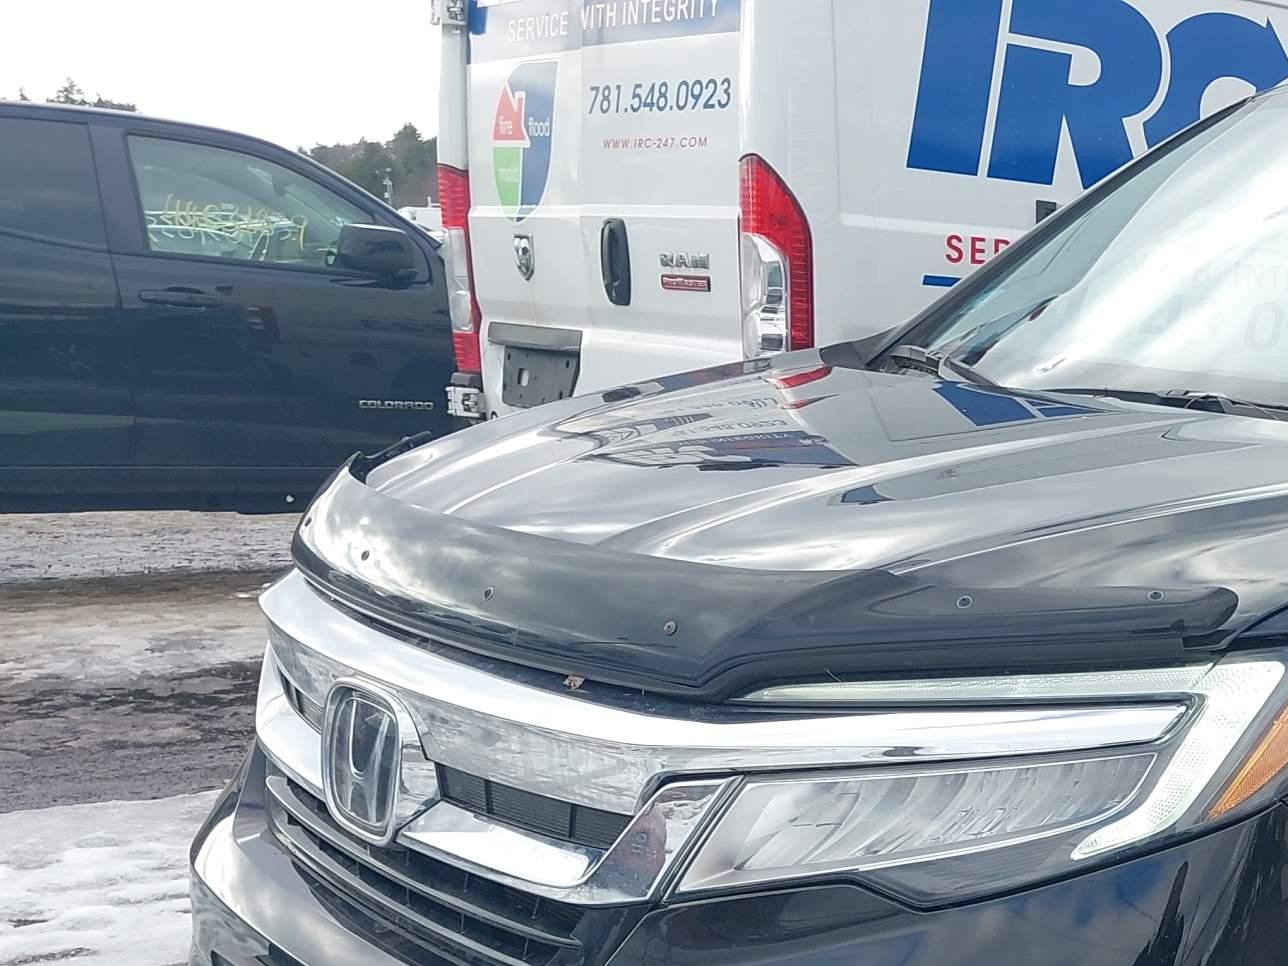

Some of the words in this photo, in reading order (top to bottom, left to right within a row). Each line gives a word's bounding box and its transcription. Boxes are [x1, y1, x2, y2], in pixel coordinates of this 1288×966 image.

[507, 11, 569, 43] SERVICE
[588, 77, 732, 115] 781.548.0923
[528, 116, 550, 137] flood
[603, 136, 708, 149] WWW.IRC-247.COM
[660, 253, 710, 269] RAM
[359, 400, 434, 410] COLORADO
